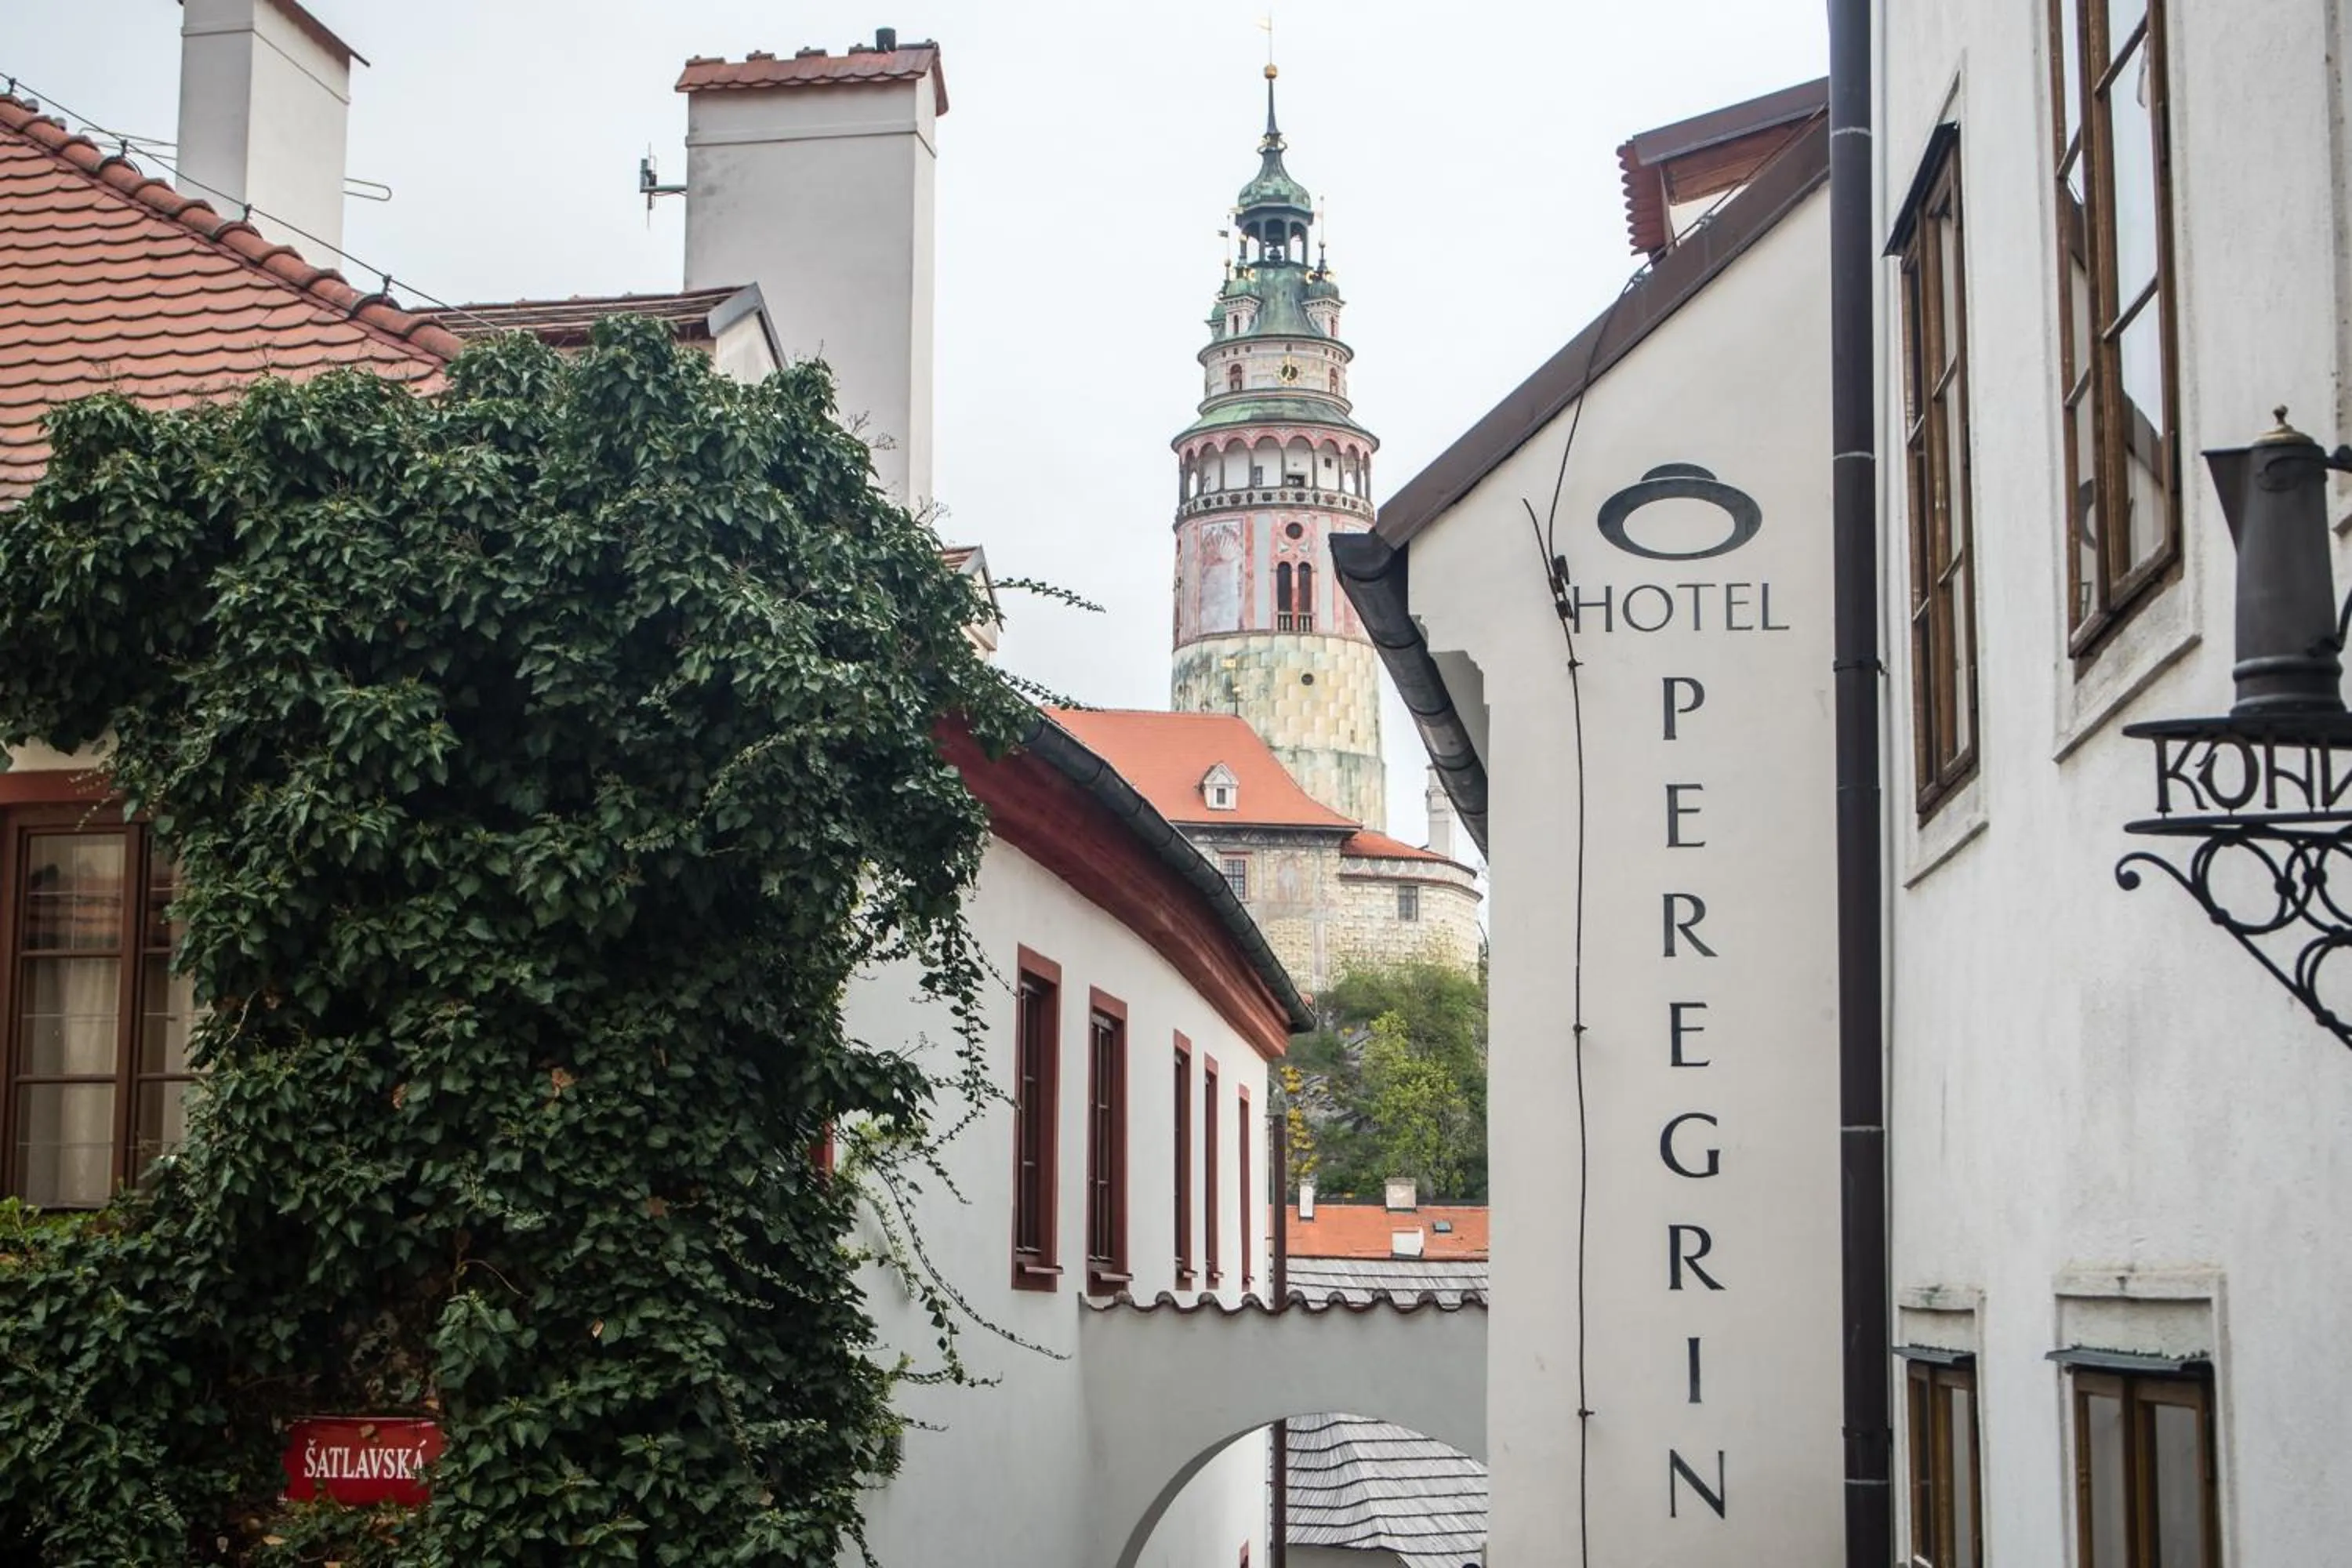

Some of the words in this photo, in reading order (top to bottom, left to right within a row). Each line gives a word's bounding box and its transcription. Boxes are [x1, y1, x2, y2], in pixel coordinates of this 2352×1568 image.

[1573, 583, 1791, 633] HOTEL
[1660, 676, 1726, 1519] PEREGRIN
[303, 1439, 428, 1479] ŠATLAVSKÁ
